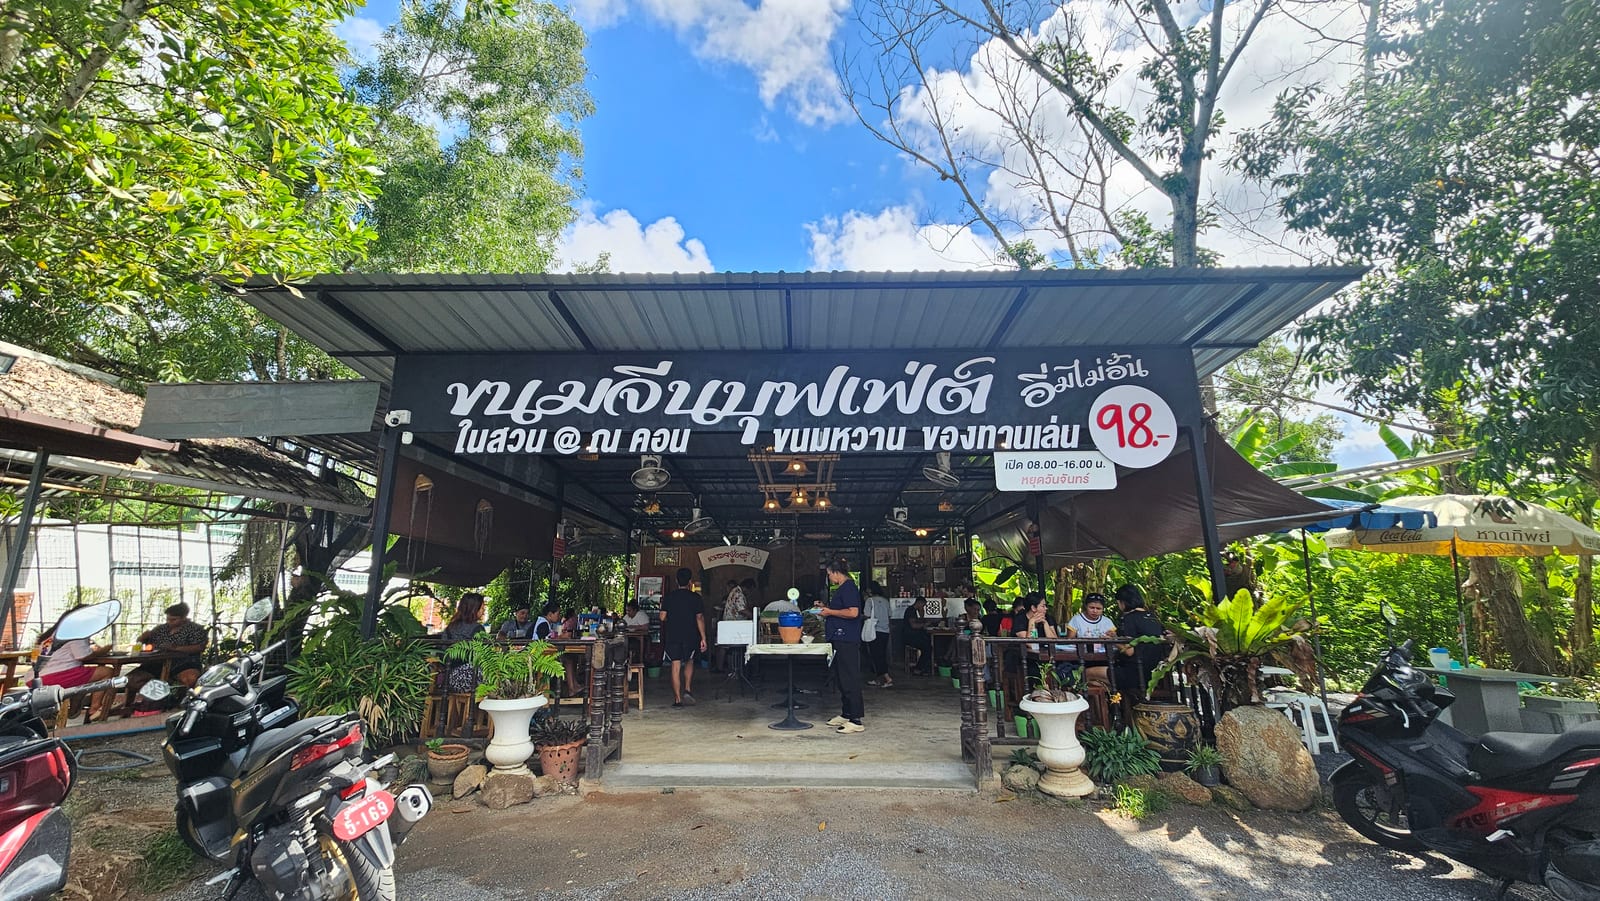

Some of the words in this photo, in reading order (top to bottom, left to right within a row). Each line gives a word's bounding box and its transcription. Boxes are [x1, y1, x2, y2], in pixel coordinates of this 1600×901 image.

[1017, 353, 1149, 408] อิ่มไม่อั้น
[447, 357, 995, 445] ขนมจีนบุฟเฟ่ต์
[455, 418, 548, 454] ในสวน
[553, 426, 582, 455] @
[588, 427, 621, 453] ณ
[628, 427, 691, 453] คอน
[773, 426, 907, 453] ขนมหวาน
[922, 415, 1081, 450] ของทานเล่น
[1005, 459, 1024, 470] เปิด
[1095, 460, 1107, 469] น.
[1020, 472, 1090, 488] หยุดวันจันทร์
[344, 801, 389, 836] 5-169
